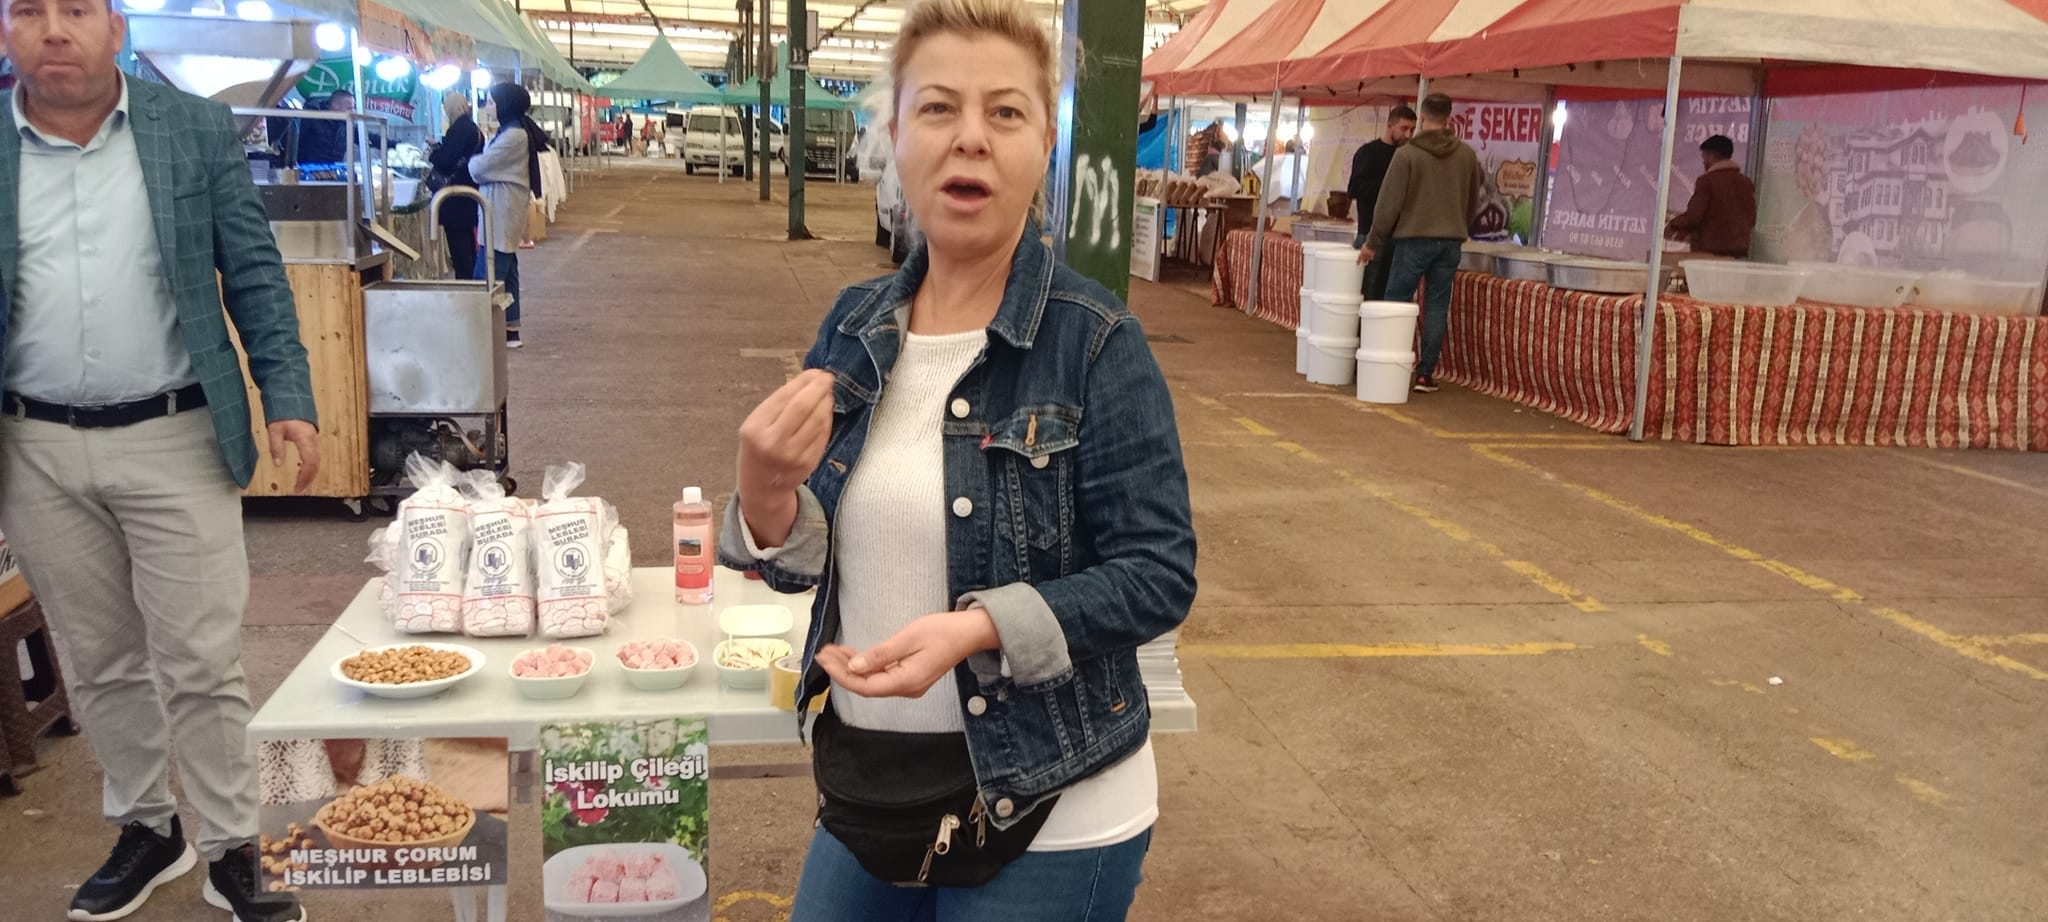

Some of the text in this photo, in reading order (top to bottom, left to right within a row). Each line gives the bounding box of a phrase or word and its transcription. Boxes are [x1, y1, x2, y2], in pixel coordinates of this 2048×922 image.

[1479, 106, 1542, 144] ŞEKER
[545, 755, 703, 783] İskilip Çileği
[577, 789, 680, 810] Lokumu
[290, 846, 477, 867] MEŞHUR ÇORUM
[284, 863, 492, 886] İSKİLİP LEBLEBİSİ
